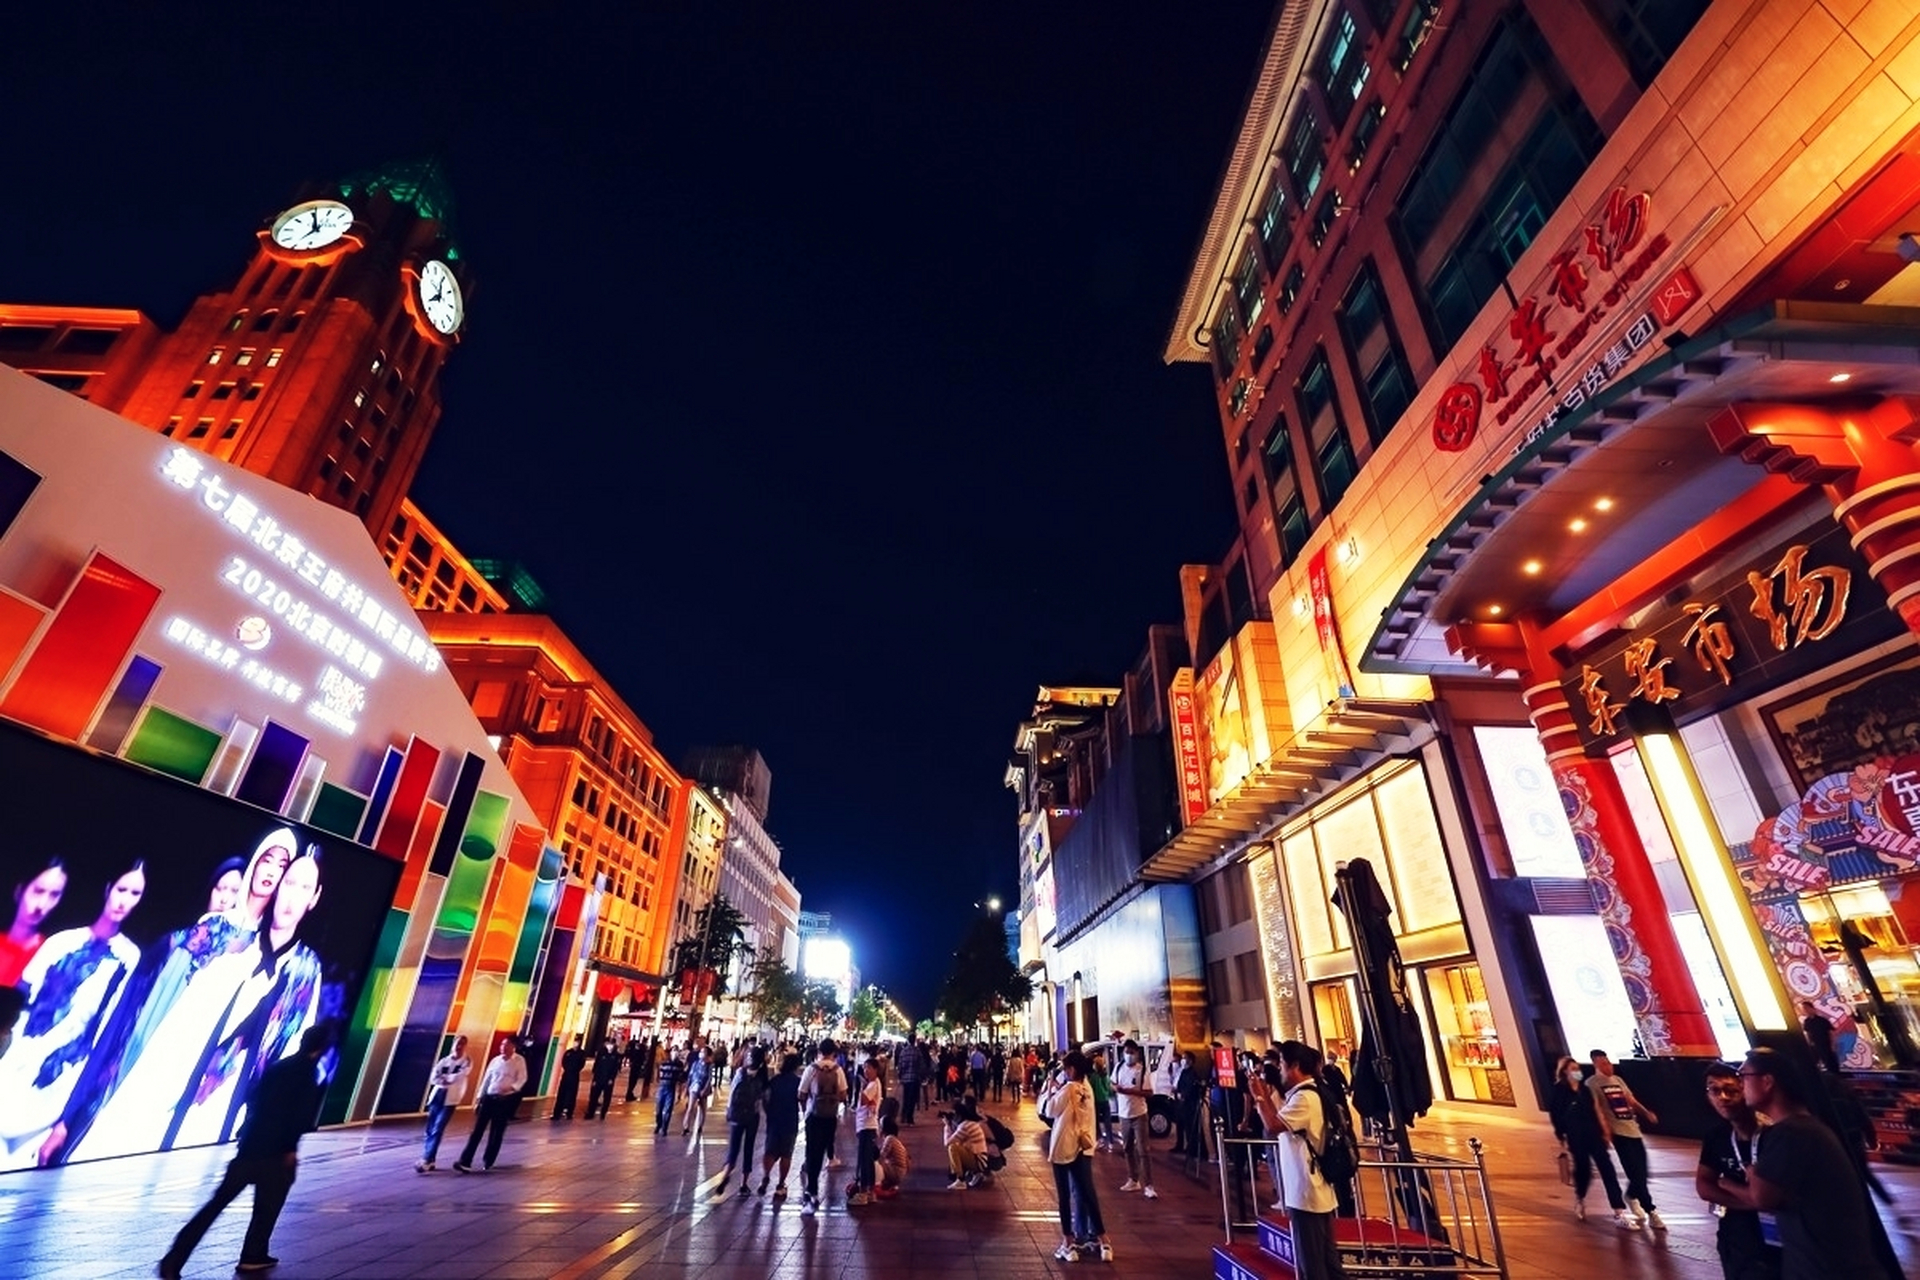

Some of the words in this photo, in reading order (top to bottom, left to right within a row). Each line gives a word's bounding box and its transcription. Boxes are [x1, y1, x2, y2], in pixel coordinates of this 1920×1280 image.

[1478, 186, 1651, 404] 东安市场
[1601, 231, 1672, 308] STORE
[162, 446, 443, 673] 第七届北京王府井国际品牌节
[1579, 545, 1851, 736] 东安市场
[1179, 722, 1203, 802] 百老汇影城
[1766, 853, 1829, 885] SALE
[1763, 920, 1799, 939] SALE
